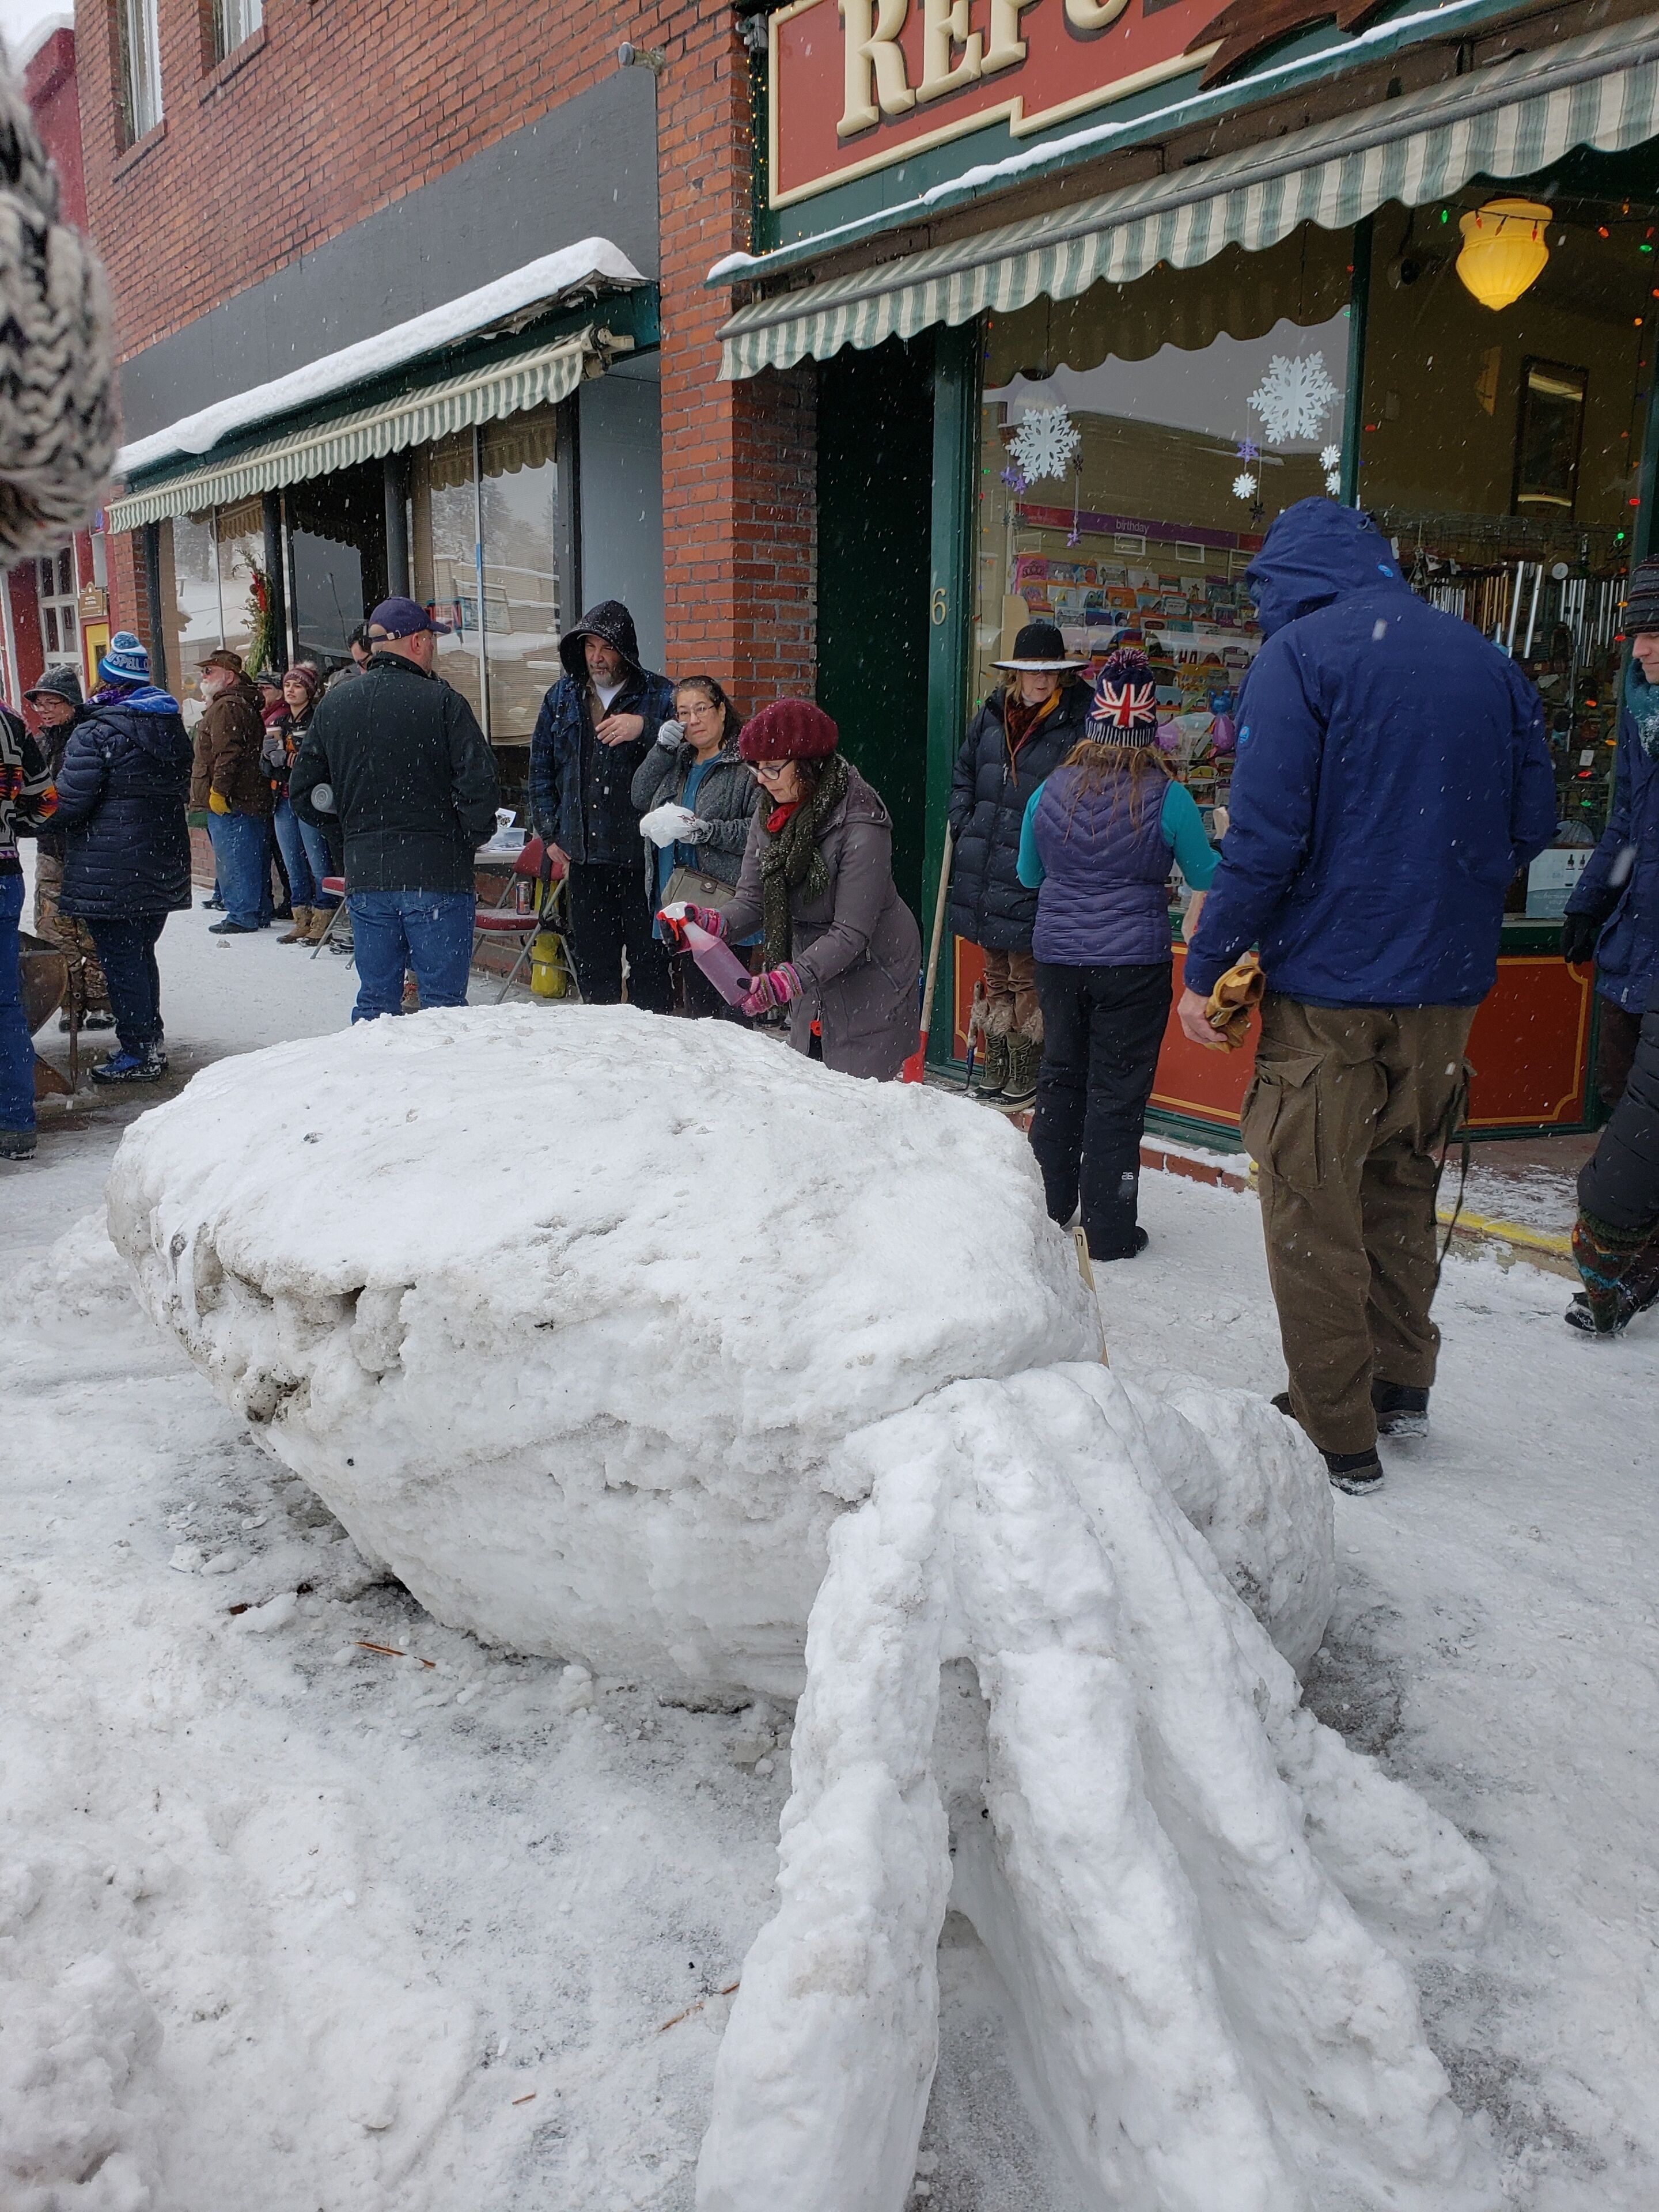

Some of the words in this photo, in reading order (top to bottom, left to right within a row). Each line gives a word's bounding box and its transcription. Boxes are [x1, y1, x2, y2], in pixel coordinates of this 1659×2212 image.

[836, 0, 1131, 137] REP
[1115, 518, 1150, 535] birthday
[931, 588, 946, 626] 6
[1074, 1233, 1084, 1247] 17
